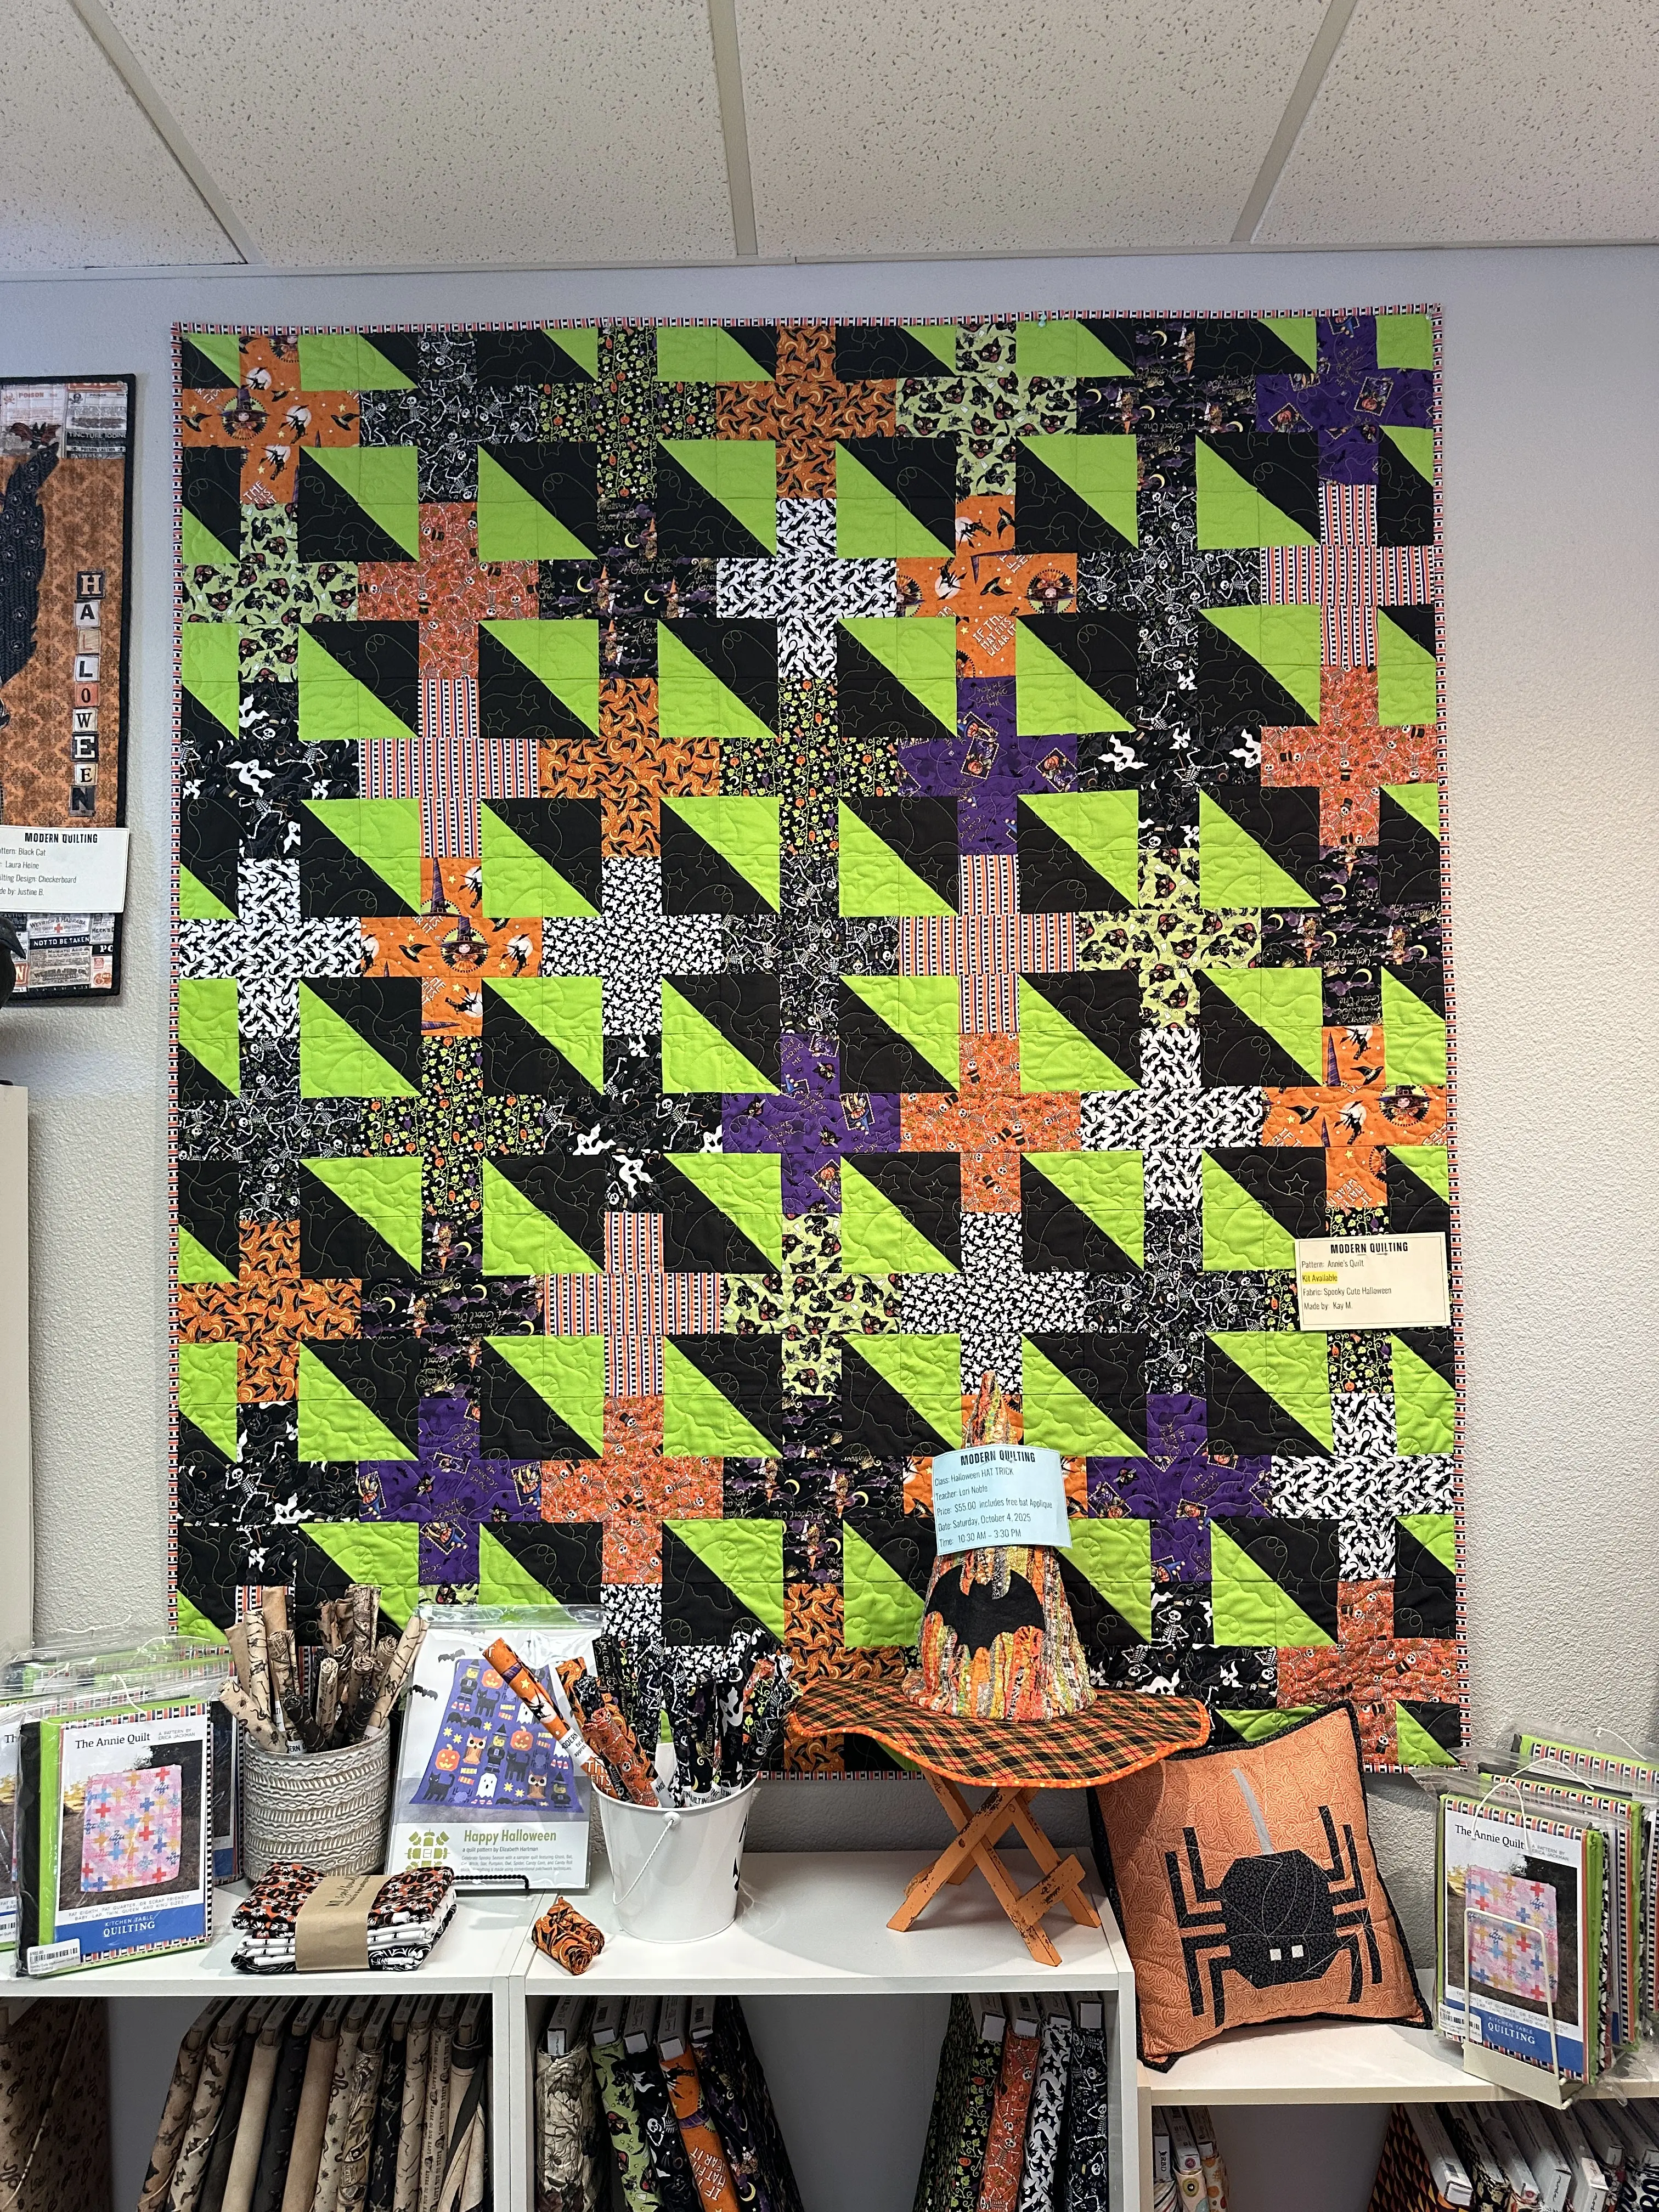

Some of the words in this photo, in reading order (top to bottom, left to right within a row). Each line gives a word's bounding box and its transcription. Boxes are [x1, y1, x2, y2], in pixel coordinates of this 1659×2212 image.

[242, 480, 266, 501] THE
[987, 635, 1010, 657] WEAR
[25, 833, 59, 843] MODERN
[62, 834, 98, 843] QUILTING
[16, 874, 37, 883] Design:
[791, 1056, 803, 1066] ME
[764, 1128, 795, 1142] SCARING
[1331, 1244, 1367, 1254] MODERN
[1370, 1242, 1408, 1252] QUILTING
[1350, 1260, 1364, 1268] Quilt
[1324, 1288, 1344, 1296] Spooky
[1321, 1302, 1330, 1311] by:
[1333, 1302, 1344, 1310] Kay
[468, 1441, 479, 1452] ME
[961, 1451, 996, 1465] MODERN
[1000, 1450, 1035, 1462] QUILTING
[935, 1478, 949, 1486] Class:
[951, 1472, 980, 1482] Halloween
[981, 1469, 993, 1477] HAT
[936, 1491, 957, 1501] Teacher:
[960, 1488, 969, 1496] Lori
[972, 1485, 988, 1494] Noble
[937, 1507, 951, 1516] Price:
[955, 1502, 976, 1513] $55.00
[979, 1499, 1004, 1508] includes
[1006, 1498, 1018, 1506] free
[1030, 1499, 1052, 1509] Applique
[938, 1523, 951, 1532] Date:
[952, 1518, 980, 1528] Saturday,
[981, 1514, 1005, 1524] October
[1007, 1513, 1013, 1522] 4,
[939, 1538, 953, 1547] Time:
[958, 1533, 974, 1543] 10:30
[977, 1531, 986, 1541] AM
[994, 1529, 1009, 1538] 3:30
[1011, 1529, 1021, 1537] PM
[76, 1740, 94, 1749] The
[96, 1736, 125, 1747] Annie
[127, 1733, 150, 1745] Quilt
[464, 1830, 499, 1846] Happy
[501, 1829, 556, 1841] Halloween
[1455, 1825, 1471, 1836] The
[1474, 1830, 1500, 1843] Annie
[1502, 1837, 1525, 1849] Quilt
[1547, 1852, 1569, 1861] JACKMAN
[103, 1921, 155, 1937] QUILTING
[105, 1918, 132, 1927] KITCHEN
[1488, 2022, 1536, 2044] QUILTING
[1489, 2016, 1514, 2028] KITCHEN
[1515, 2024, 1532, 2034] TABLE
[706, 2170, 726, 2187] HAT
